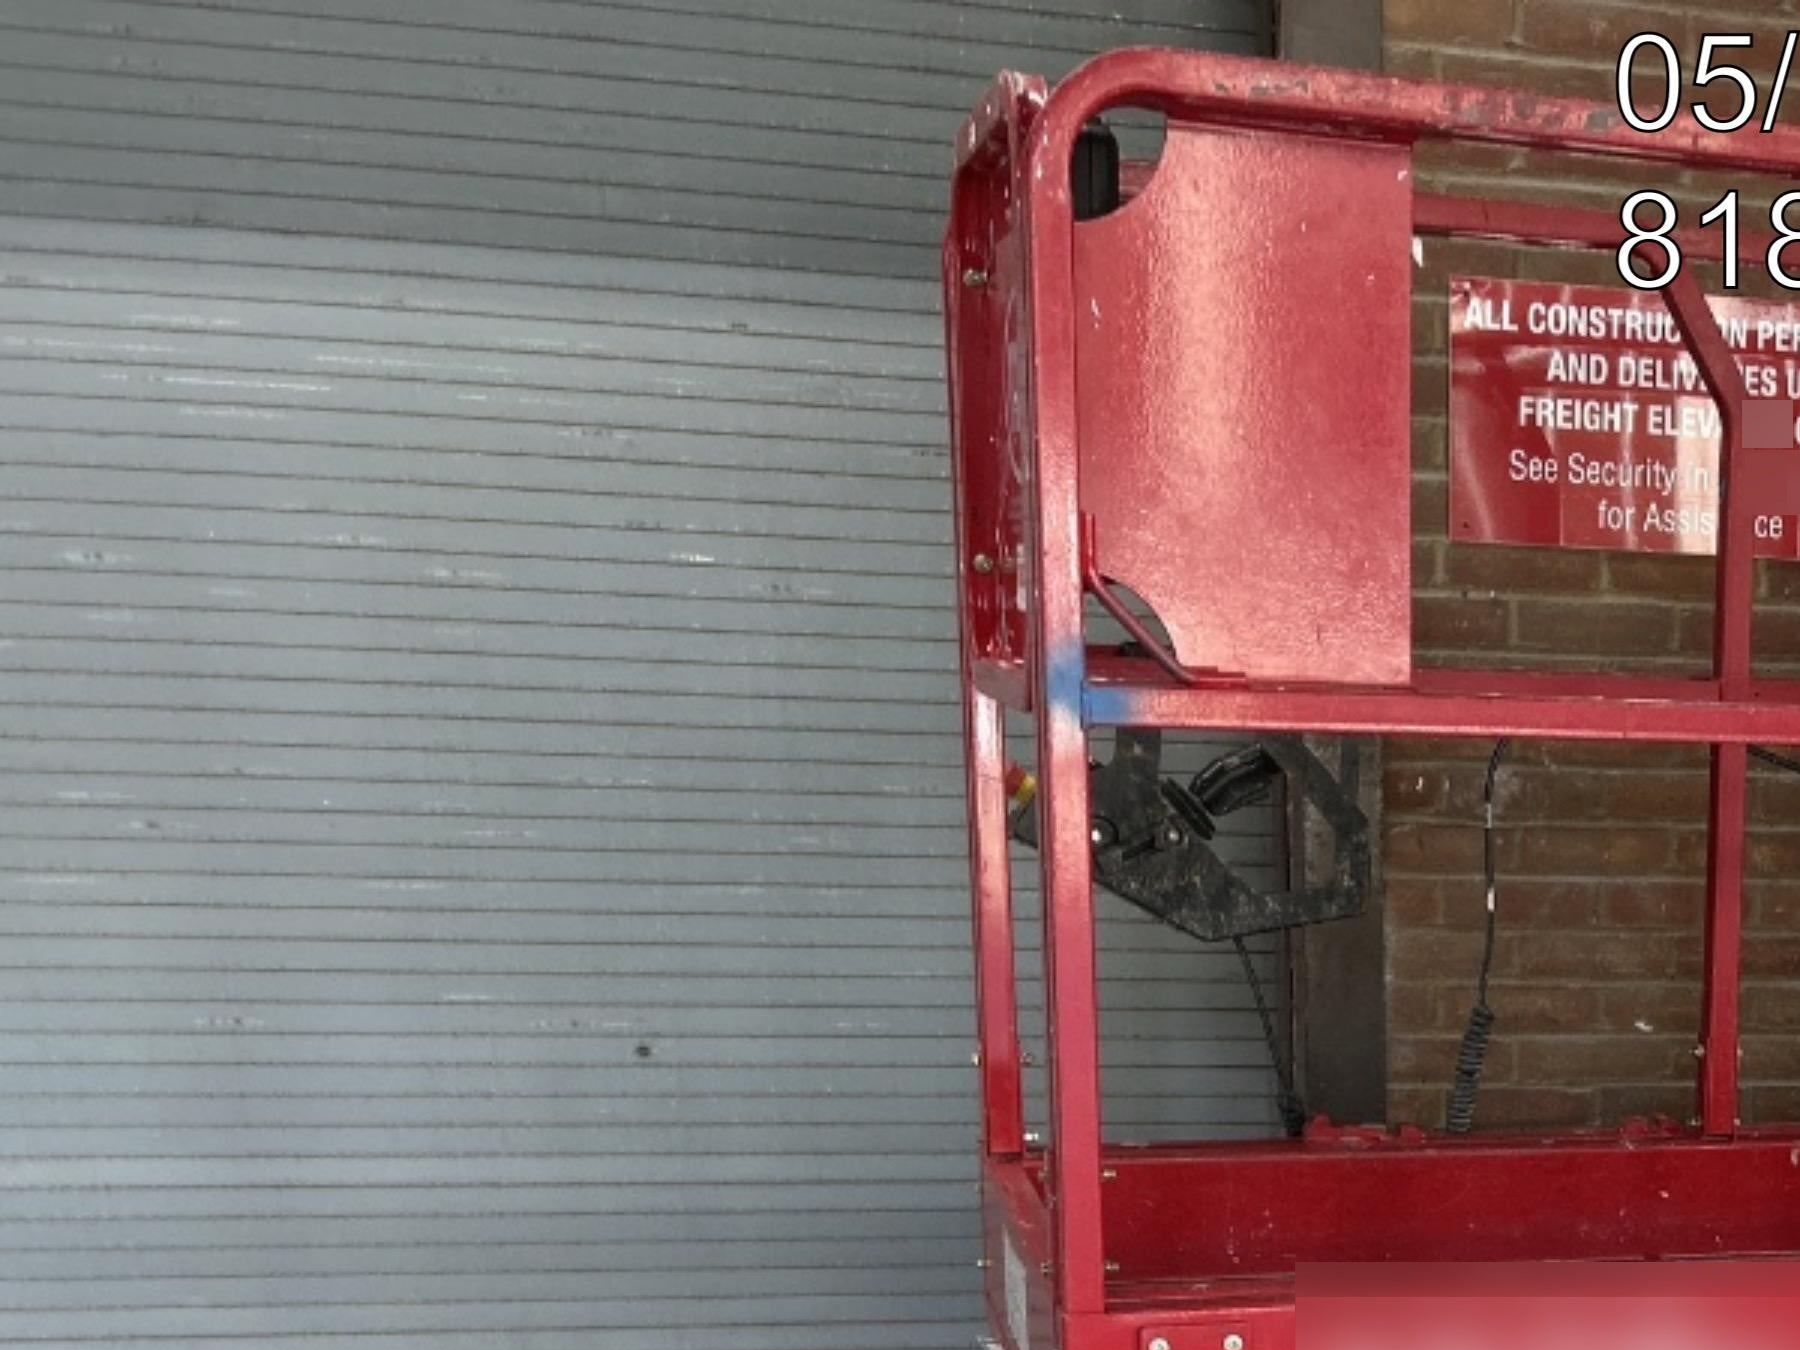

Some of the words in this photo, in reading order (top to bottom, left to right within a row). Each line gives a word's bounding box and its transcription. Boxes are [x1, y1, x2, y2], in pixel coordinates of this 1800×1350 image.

[1464, 297, 1519, 332] ALL
[1528, 302, 1747, 349] CONSTRUCN
[1547, 350, 1609, 385] AND
[1618, 357, 1777, 398] DELIVES
[1519, 395, 1639, 434] FREIGHT
[1508, 449, 1559, 482] See
[1567, 452, 1677, 495] Security
[1597, 500, 1637, 530] for
[1643, 502, 1783, 538] Assisce
